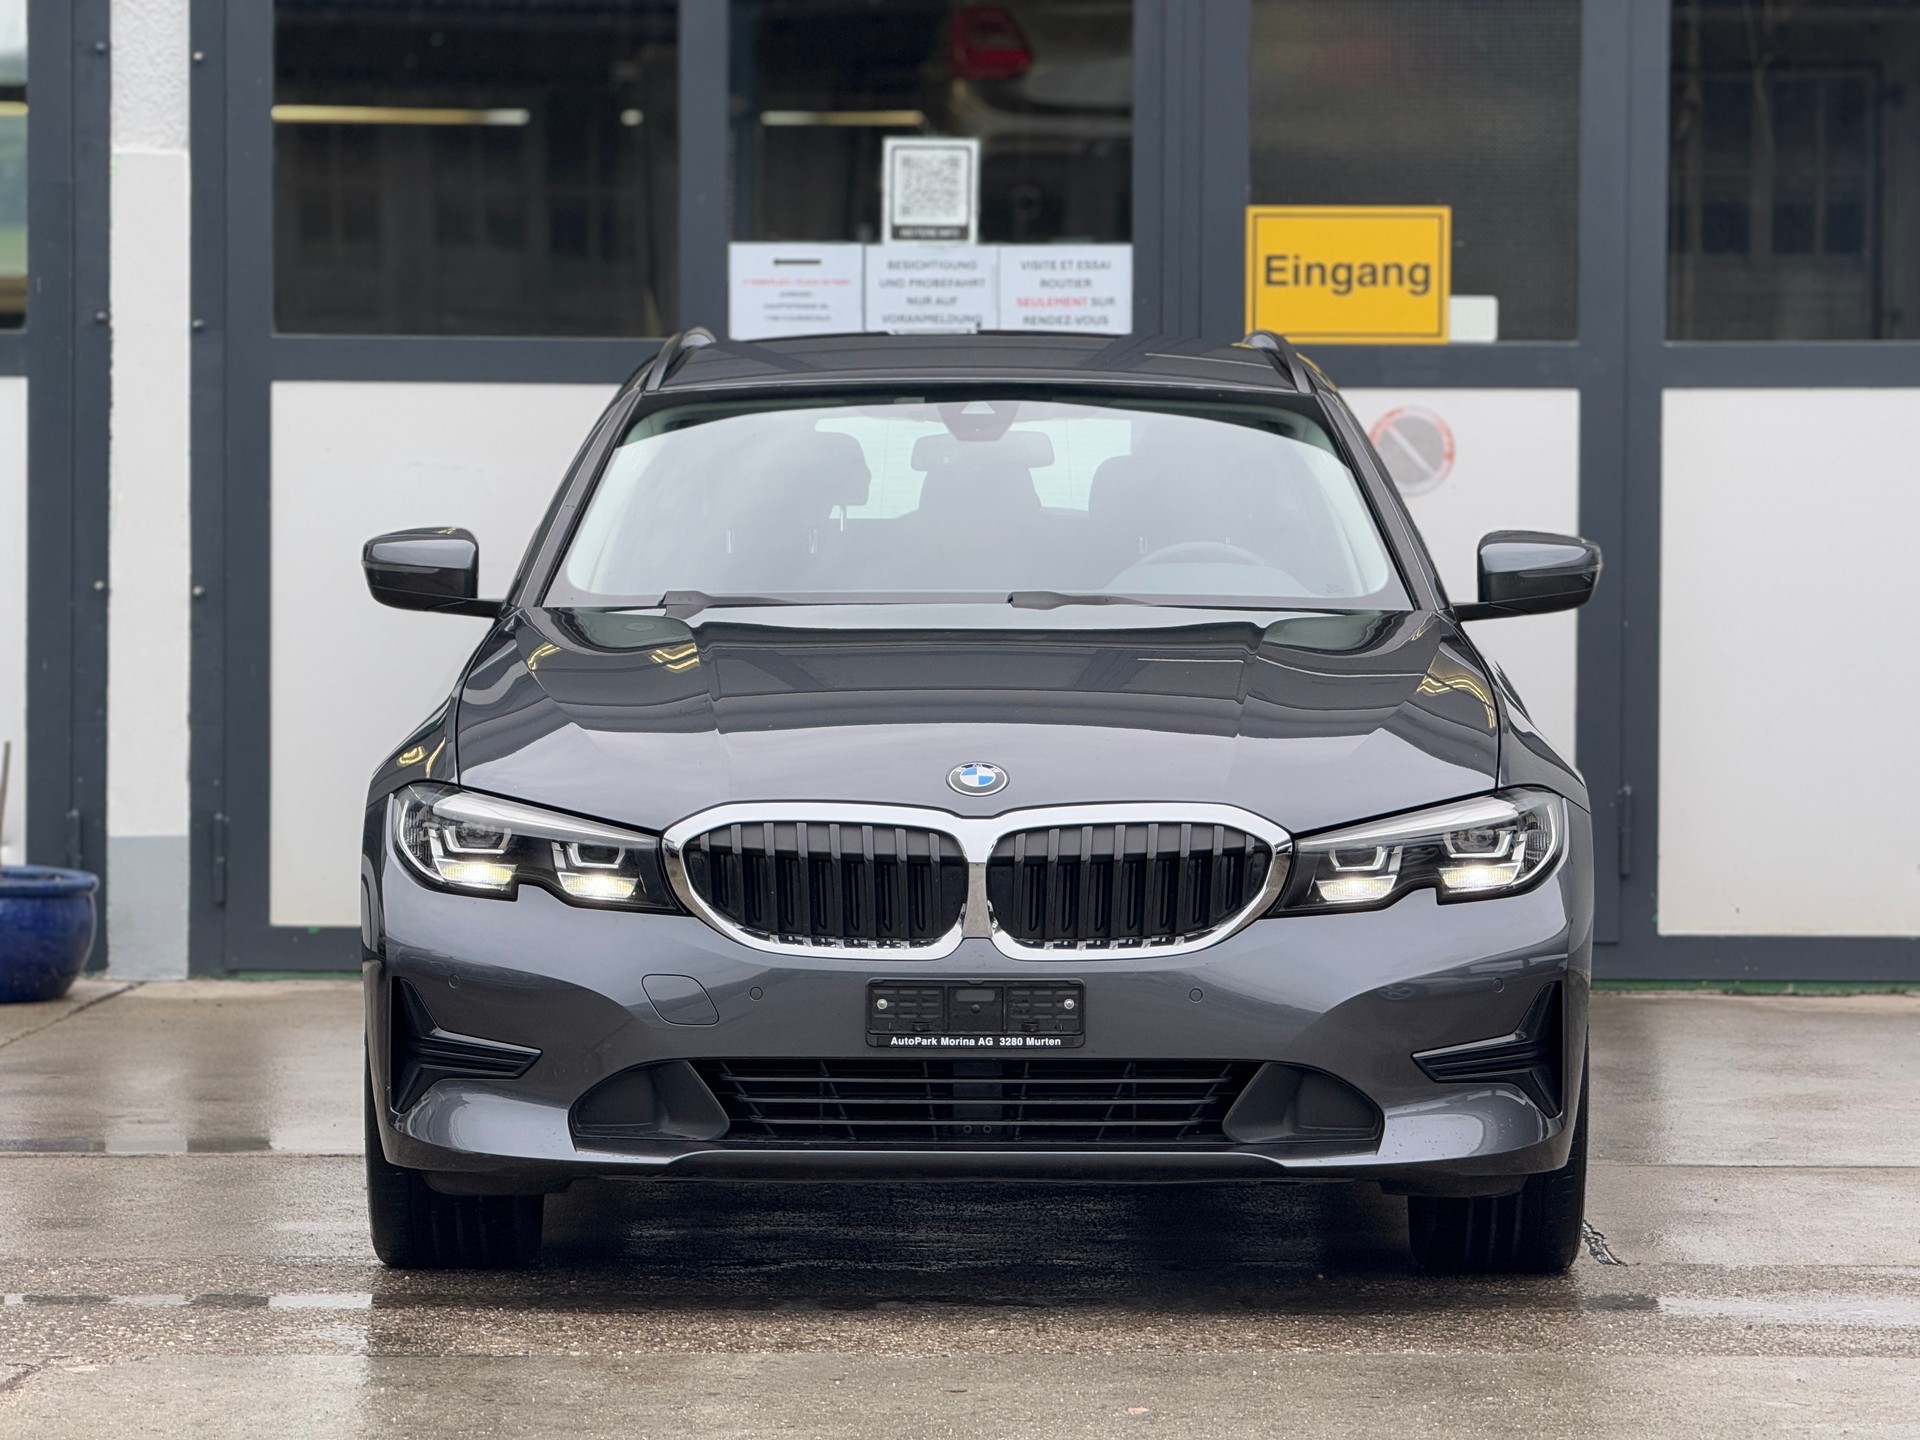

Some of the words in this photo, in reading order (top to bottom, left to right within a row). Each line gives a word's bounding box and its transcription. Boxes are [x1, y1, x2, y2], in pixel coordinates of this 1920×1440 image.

[888, 261, 976, 270] BESICHTIGUNG
[1021, 261, 1056, 270] VISITE
[1060, 261, 1074, 270] ET
[1076, 261, 1111, 270] ESSAI
[1265, 255, 1431, 296] Eingang
[880, 279, 905, 288] UND
[909, 279, 985, 288] PROBEFAHRT
[1040, 279, 1092, 288] ROUTIER
[906, 297, 931, 305] NUR
[935, 297, 957, 305] AUF
[1017, 298, 1087, 307] SEULEMENT
[1091, 297, 1115, 306] SUR
[883, 314, 982, 323] VORANMELDUNG
[1023, 315, 1108, 324] RENDEZ-VOUS
[890, 1036, 938, 1046] AutoPark
[940, 1036, 976, 1046] Morina
[978, 1036, 994, 1046] AG
[999, 1036, 1024, 1046] 3280
[1026, 1036, 1062, 1046] Murten
